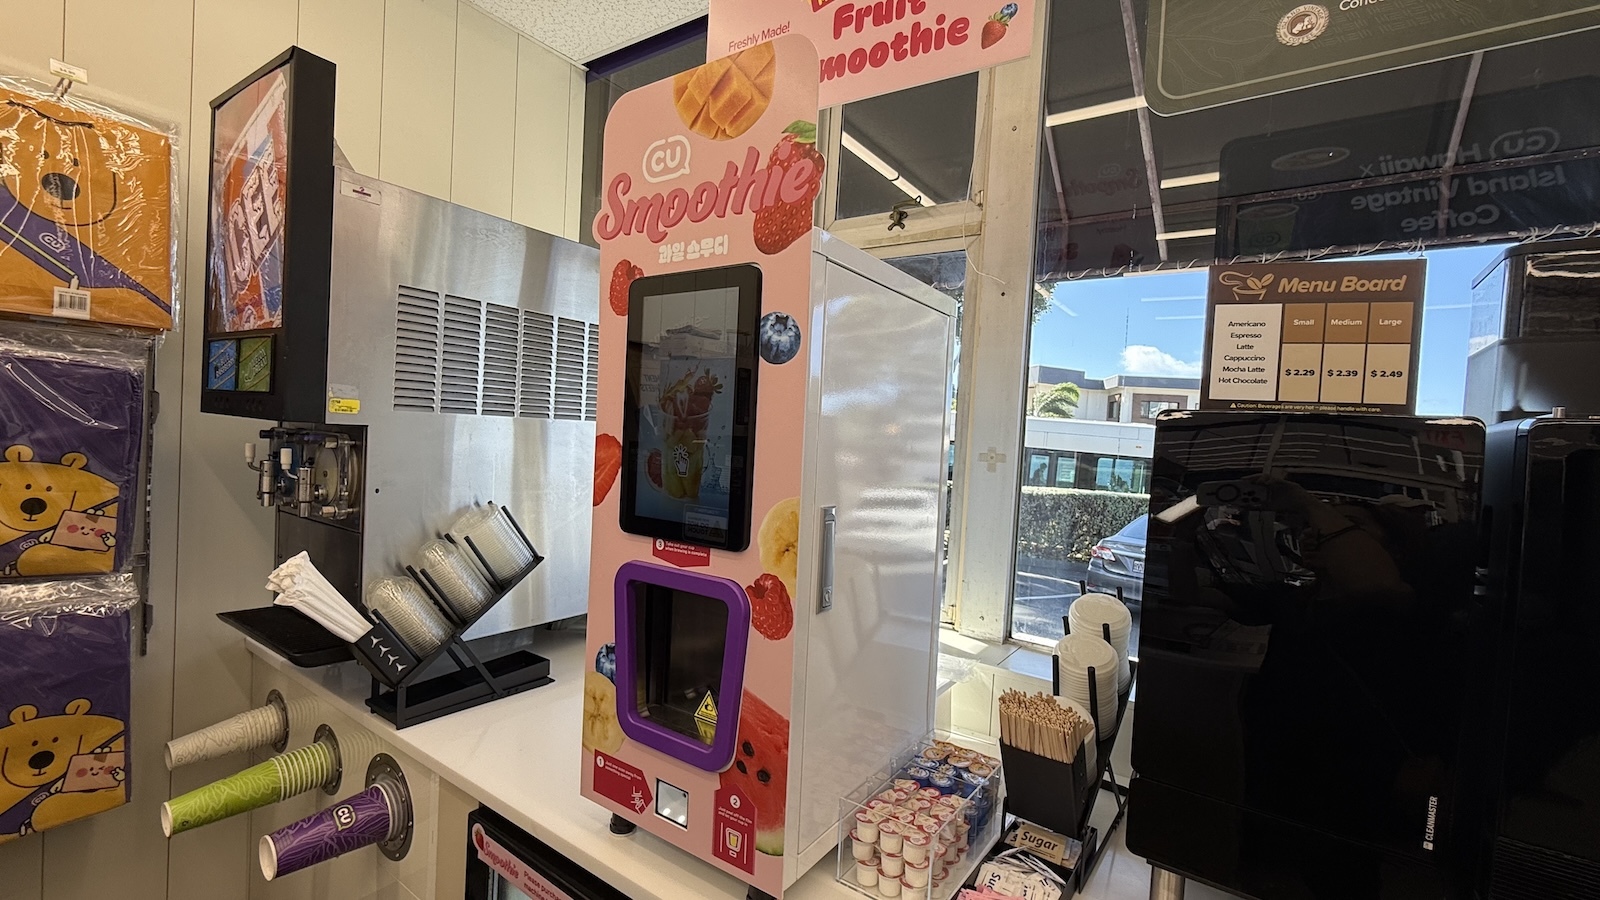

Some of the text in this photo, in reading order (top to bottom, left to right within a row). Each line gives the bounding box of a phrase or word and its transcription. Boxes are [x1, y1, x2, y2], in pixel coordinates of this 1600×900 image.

[833, 0, 926, 40] Fruit
[728, 20, 790, 52] Freshly Made!
[820, 13, 970, 83] moothie
[651, 145, 681, 173] CU
[597, 146, 816, 244] Smoothie
[658, 234, 729, 264] 과일 스무디
[1277, 274, 1407, 293] Menu Board
[1379, 318, 1403, 327] Large
[1285, 368, 1292, 377] $
[1327, 369, 1334, 377] $
[1371, 370, 1378, 378] $
[338, 808, 351, 824] CU
[1425, 796, 1438, 841] CLEANMASTER
[1021, 831, 1058, 851] Sugar
[483, 841, 520, 879] Smoothie
[524, 871, 541, 889] Please
